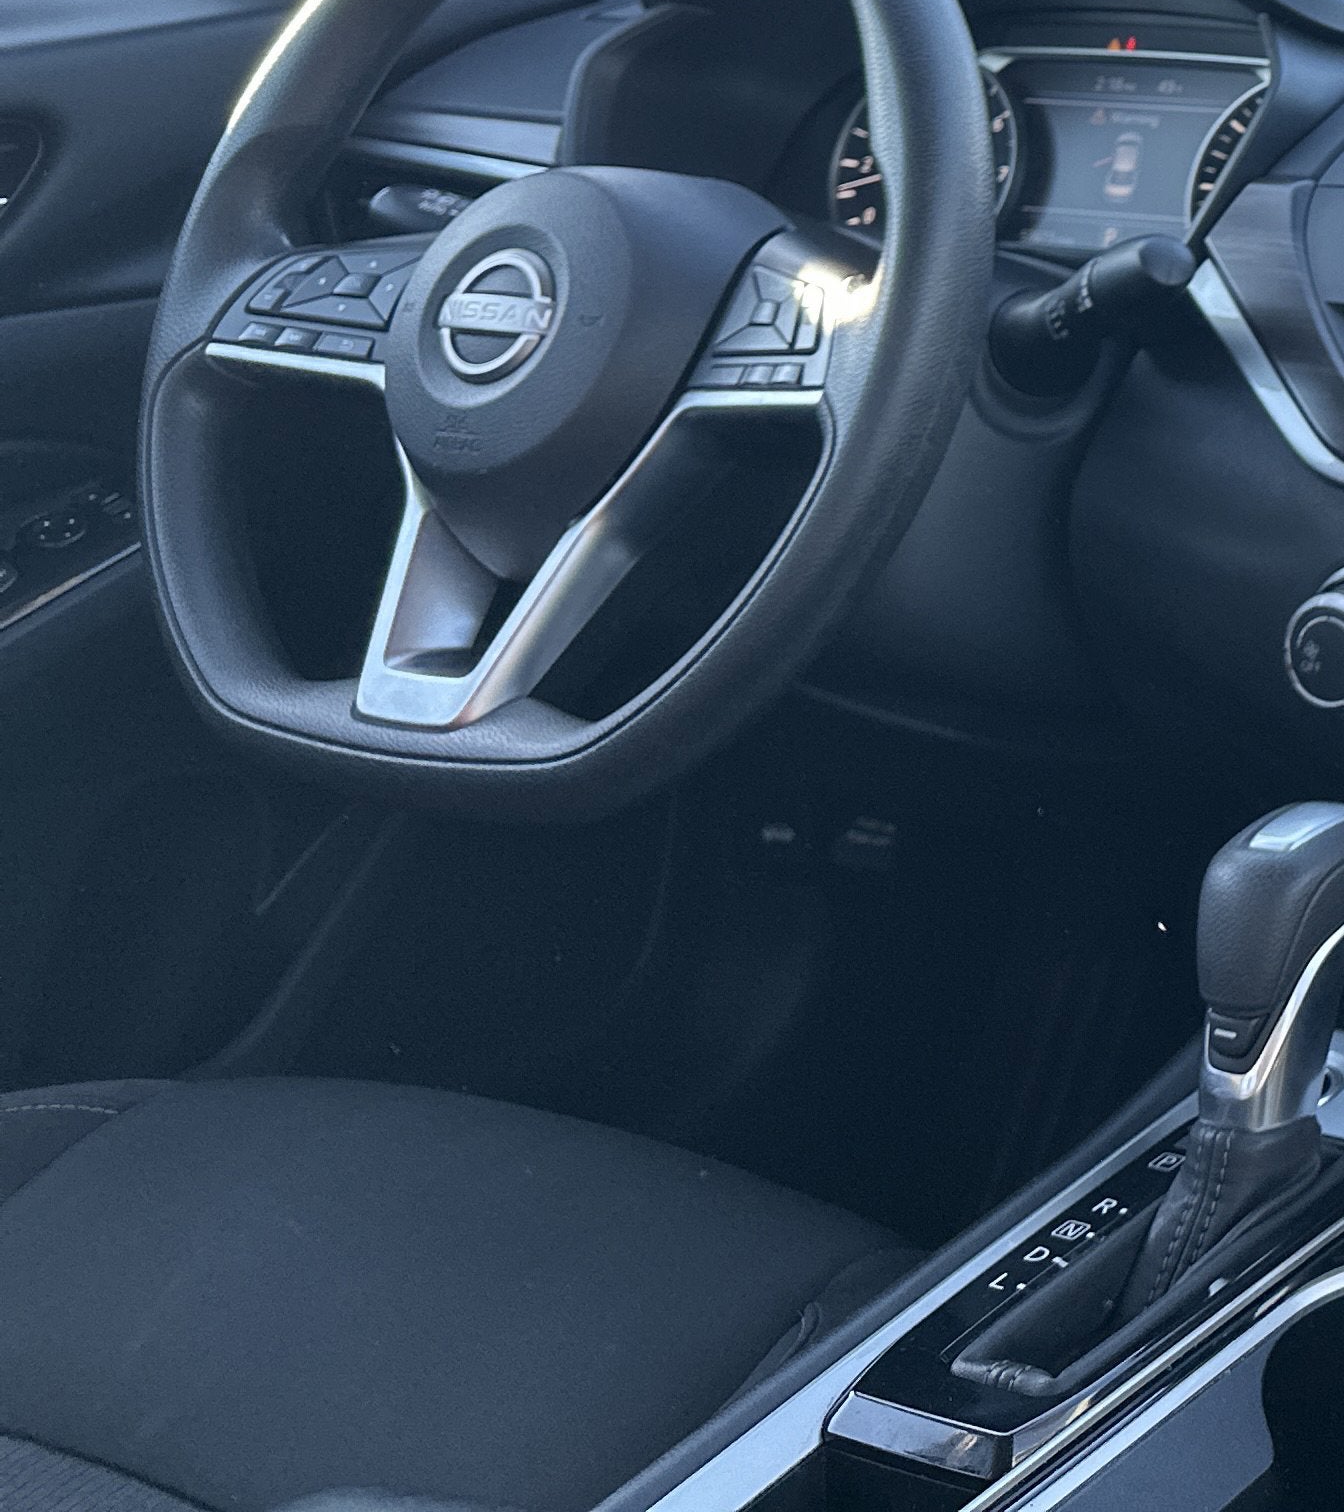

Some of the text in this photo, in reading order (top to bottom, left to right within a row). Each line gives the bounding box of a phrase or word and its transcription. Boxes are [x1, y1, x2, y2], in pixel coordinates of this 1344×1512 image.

[859, 155, 874, 174] 2
[1092, 1197, 1118, 1214] R
[1023, 1246, 1051, 1262] D
[988, 1272, 1009, 1290] L
